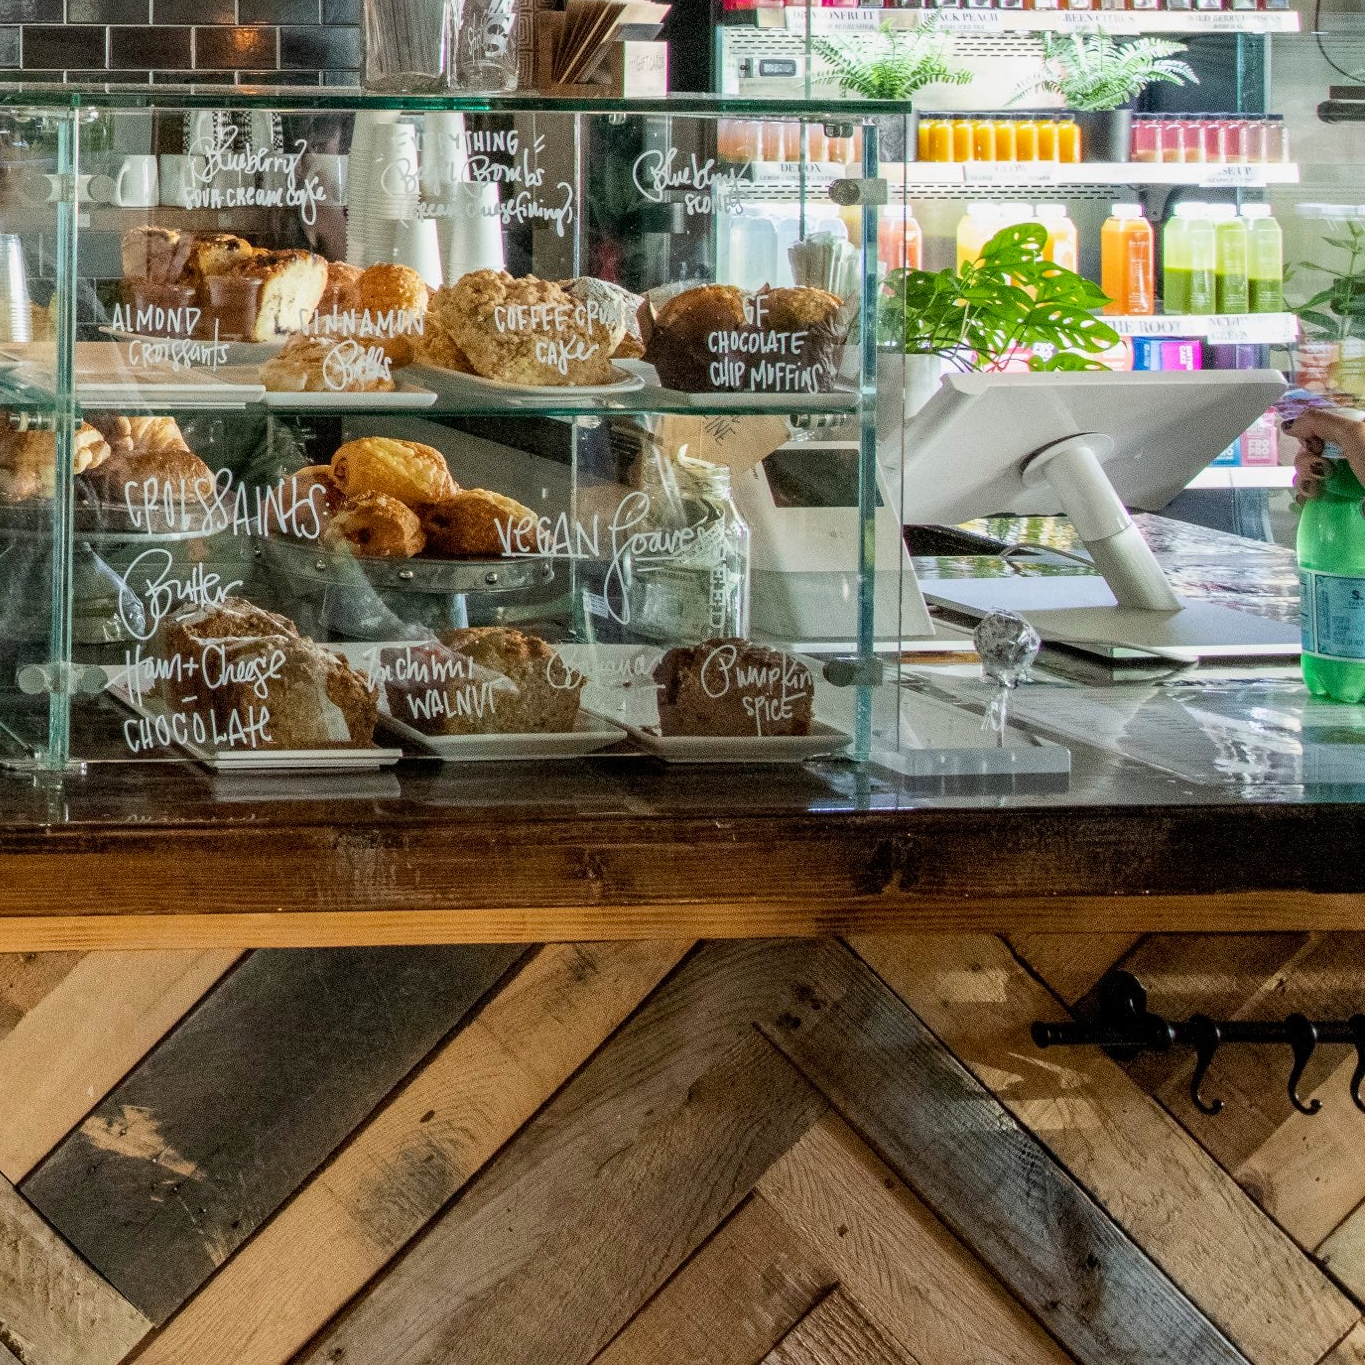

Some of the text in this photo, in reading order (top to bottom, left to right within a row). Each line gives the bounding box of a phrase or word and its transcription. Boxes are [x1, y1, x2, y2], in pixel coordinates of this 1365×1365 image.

[923, 12, 998, 22] BACK PEACH
[188, 125, 307, 190] Blueberry
[395, 129, 519, 155] EVYTHING
[461, 147, 545, 198] Bombs
[112, 303, 201, 332] ALMOND
[299, 303, 426, 338] CINNAMON
[494, 301, 575, 333] COFFEE
[708, 330, 808, 355] CHOCOLATE
[709, 361, 744, 387] CHIP
[493, 512, 599, 557] VEGAN
[119, 548, 244, 641] Butter
[701, 645, 814, 699] Pumpkin
[407, 682, 499, 720] WALNUT
[123, 706, 272, 752] CHOCOLATE
